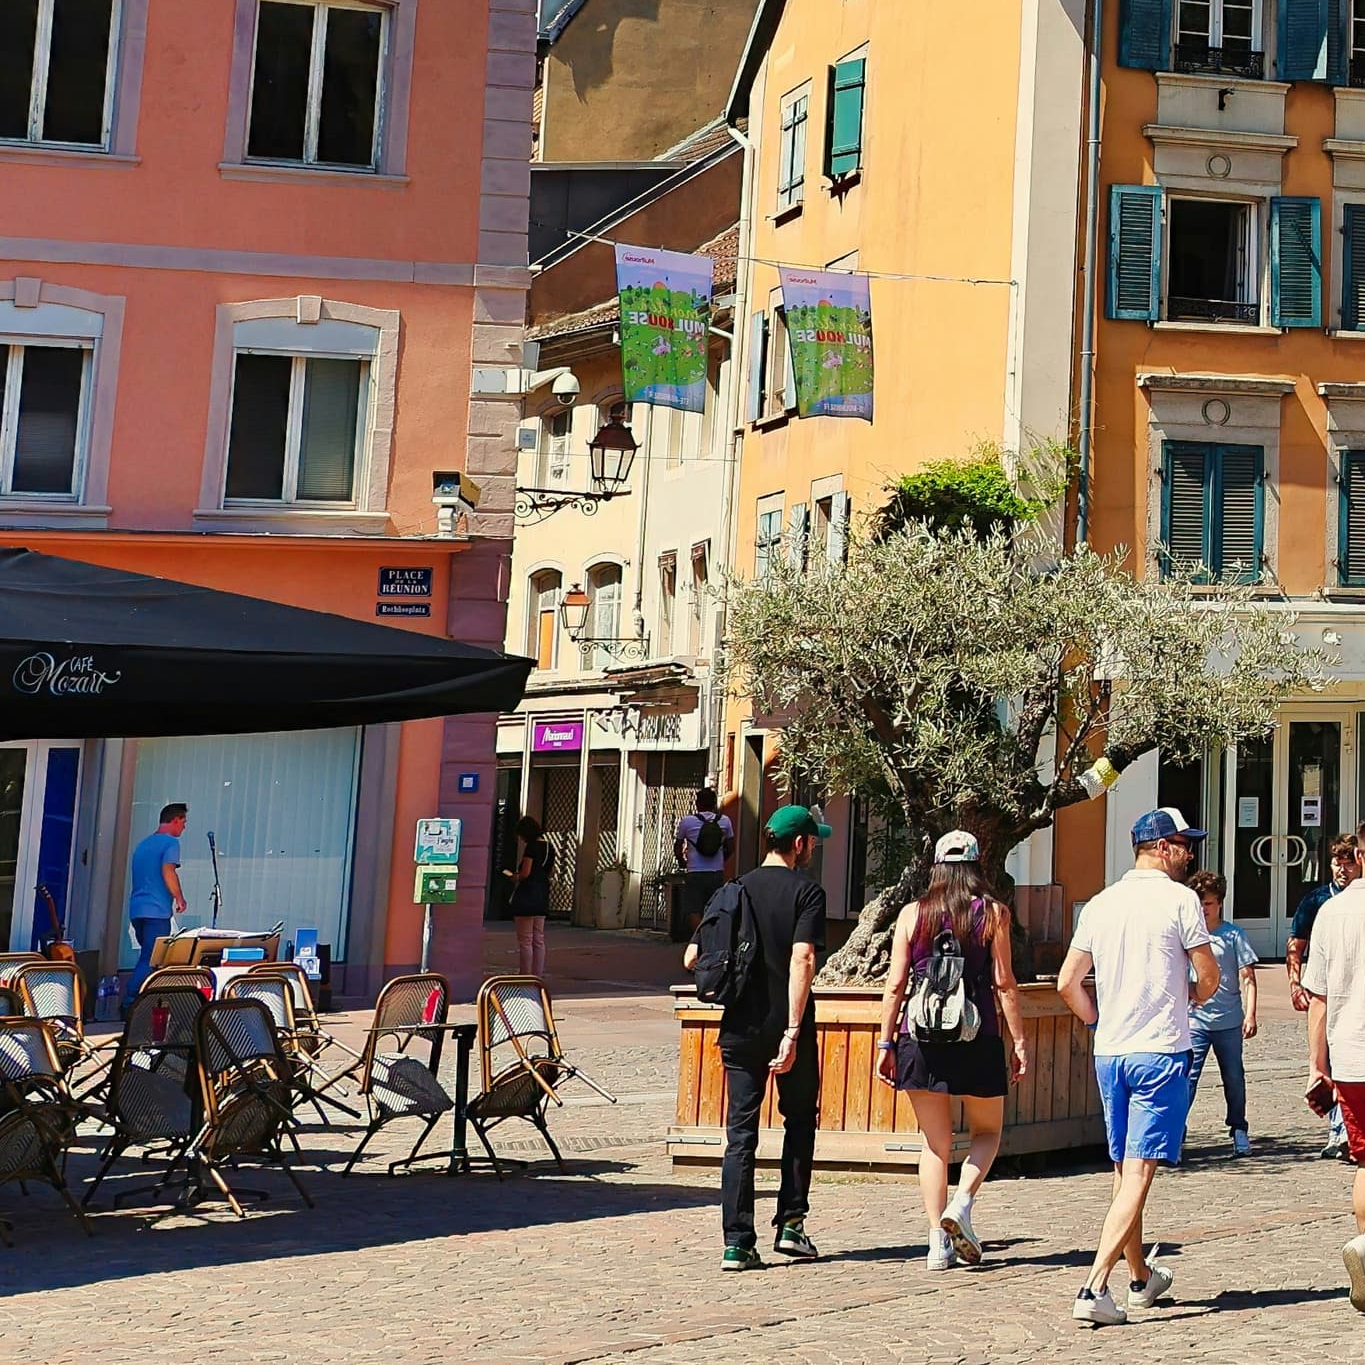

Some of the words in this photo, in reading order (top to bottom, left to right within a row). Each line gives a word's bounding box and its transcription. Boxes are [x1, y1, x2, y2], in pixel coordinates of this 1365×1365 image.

[389, 570, 424, 580] PLACE
[382, 583, 429, 594] RÉUNION
[70, 655, 94, 673] CAFÉ
[13, 651, 121, 695] Mozart
